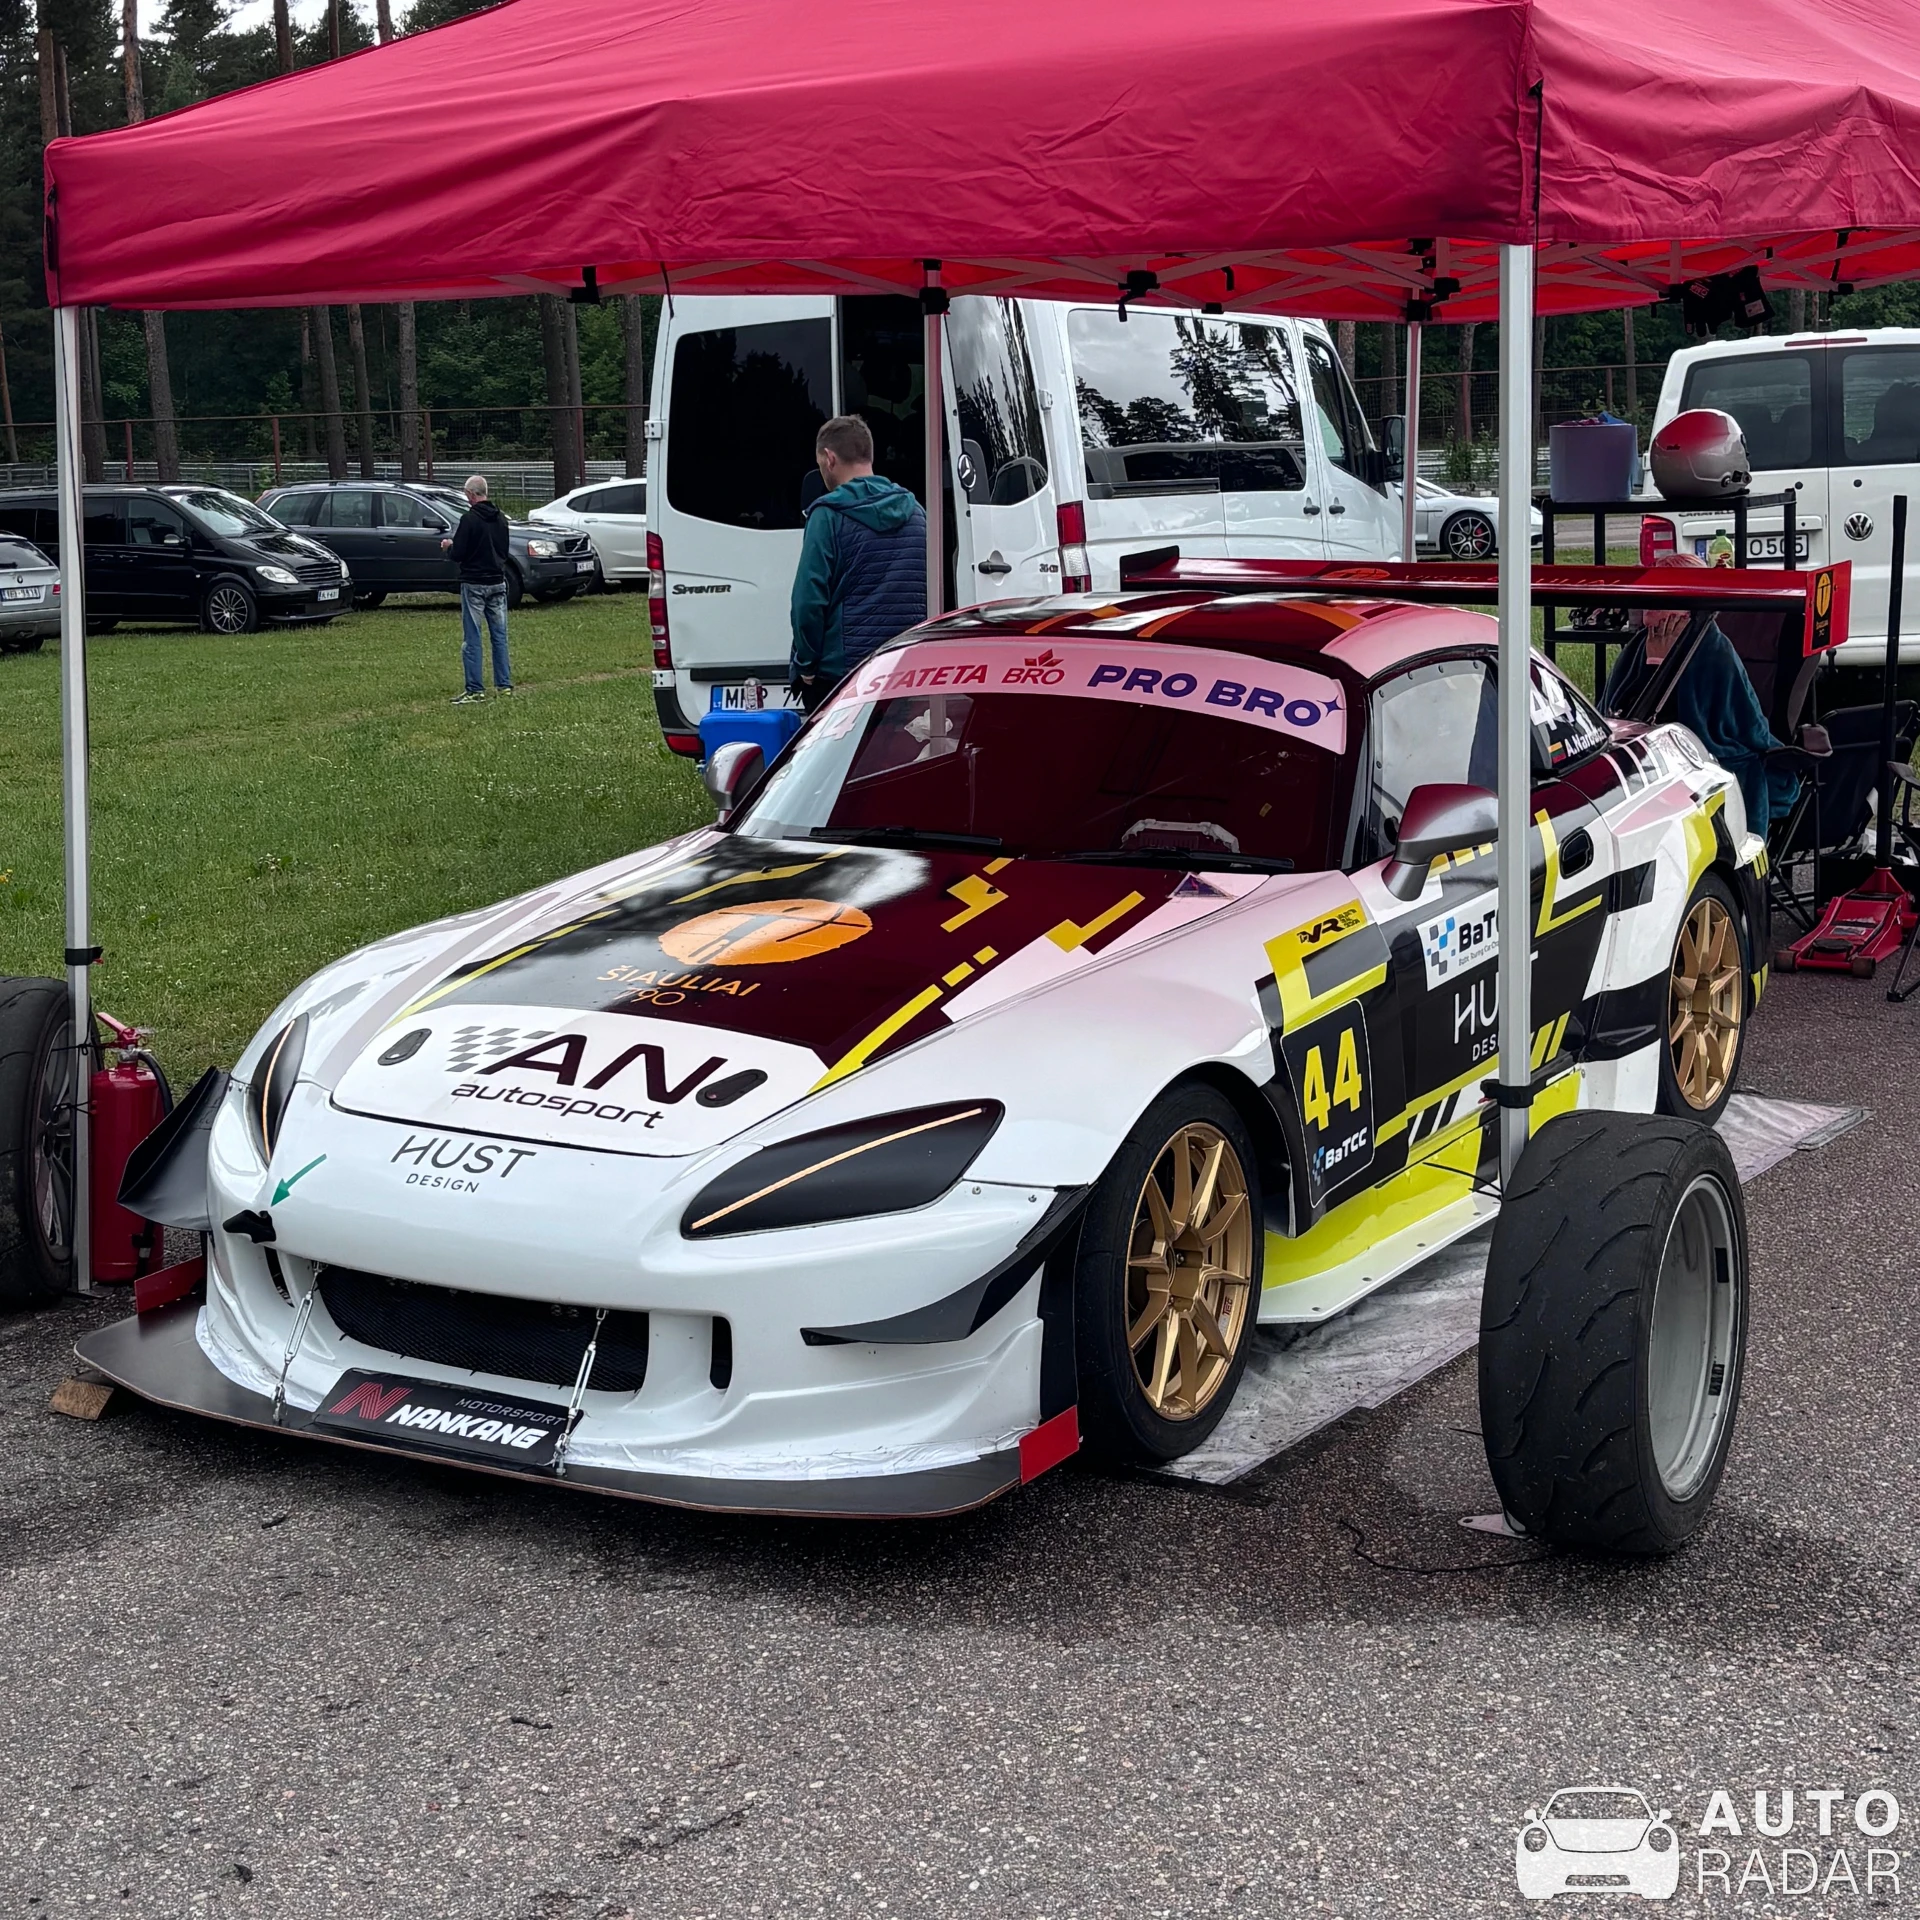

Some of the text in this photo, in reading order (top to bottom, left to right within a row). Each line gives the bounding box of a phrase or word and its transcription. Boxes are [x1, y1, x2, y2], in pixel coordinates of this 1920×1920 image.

[864, 664, 1321, 727] STATETA BRO PRO BRO
[1459, 909, 1499, 953] BaT
[597, 964, 761, 997] ŠIAULIAI
[474, 1033, 729, 1105] AN
[1303, 1027, 1363, 1132] 44
[450, 1083, 665, 1129] autosport
[390, 1134, 538, 1178] HUST
[1325, 1126, 1368, 1170] BaTCC
[405, 1173, 480, 1193] DESIGN
[385, 1403, 550, 1450] NANKANG
[455, 1398, 567, 1426] MOTORSPORT
